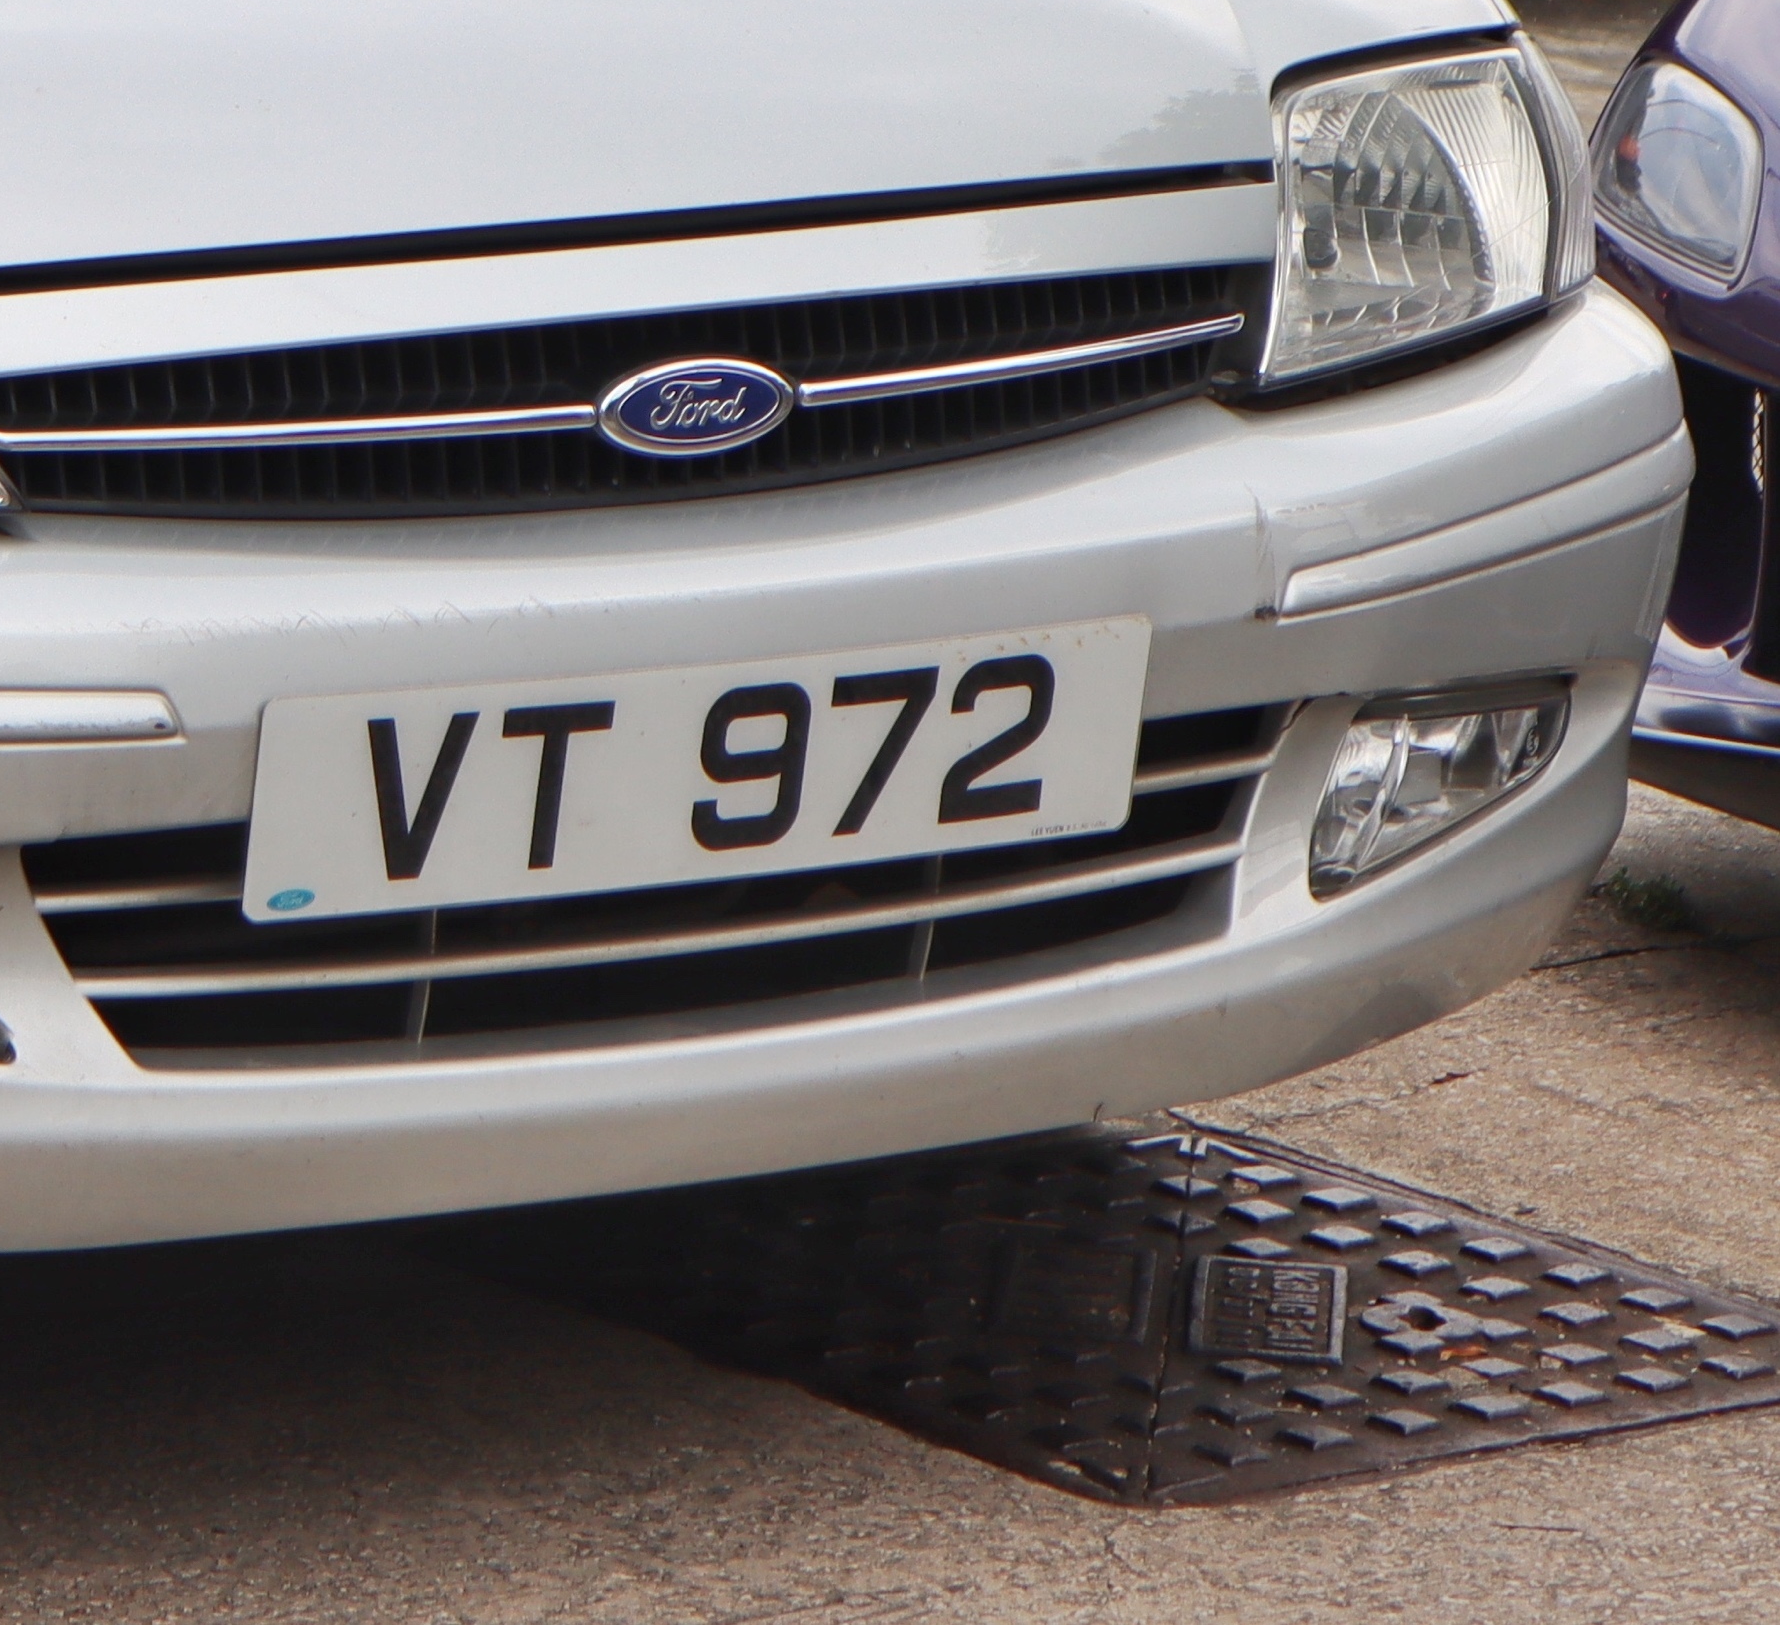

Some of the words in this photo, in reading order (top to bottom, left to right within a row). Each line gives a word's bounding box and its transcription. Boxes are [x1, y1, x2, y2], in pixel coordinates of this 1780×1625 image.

[650, 378, 748, 430] Ford
[367, 700, 616, 881] VT
[691, 653, 1055, 852] 972
